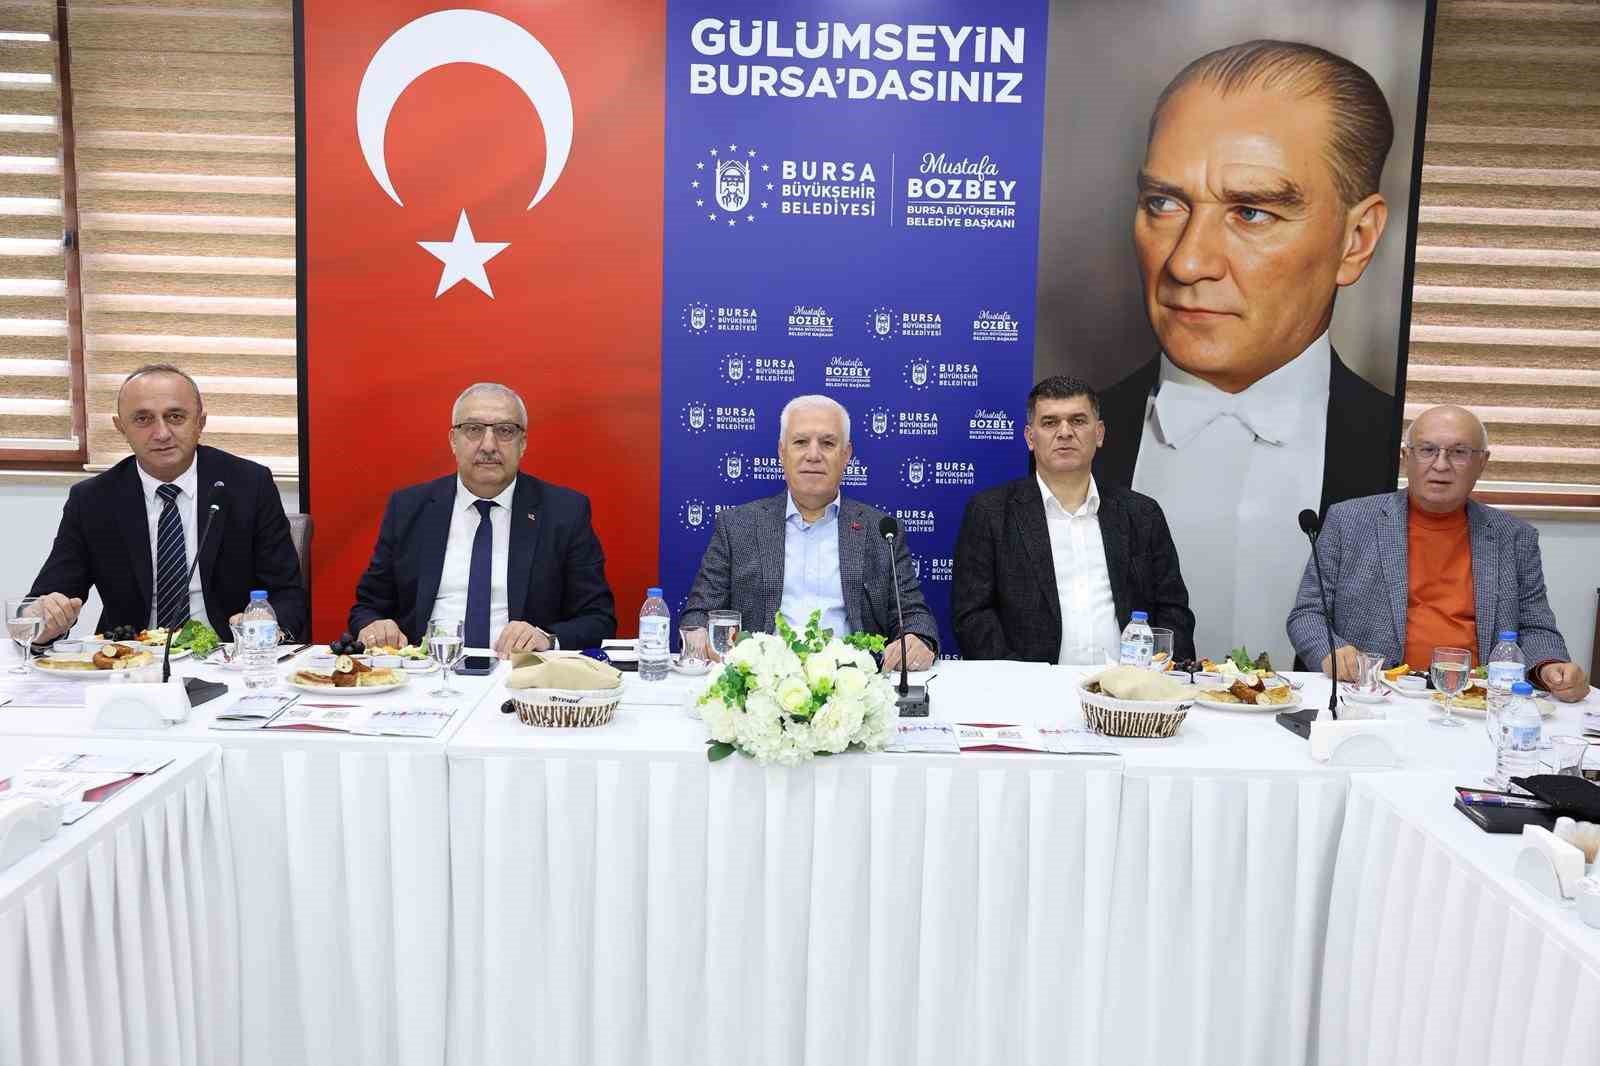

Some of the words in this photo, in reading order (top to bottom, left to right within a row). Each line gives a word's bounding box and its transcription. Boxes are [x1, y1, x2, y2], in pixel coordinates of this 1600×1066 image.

[690, 17, 1025, 64] GÜLÜMSEYİN
[782, 160, 876, 182] BURSA
[920, 152, 1000, 182] Mustafa
[782, 182, 875, 200] BÜYÜKŞEHİR
[907, 178, 1016, 200] BOZBEY
[781, 200, 875, 216] BELEDİYESİ
[907, 205, 944, 215] BURSA
[946, 205, 1015, 217] BÜYÜKŞEHİR
[906, 216, 961, 227] BELEDİYE
[964, 217, 1015, 230] BAŞKANI
[718, 308, 757, 317] BURSA
[788, 316, 833, 325] BOZBEY
[903, 313, 941, 322] BURSA
[973, 320, 1018, 329] BOZBEY
[756, 359, 794, 368] BURSA
[939, 364, 978, 372] BURSA
[825, 367, 871, 376] BOZBEY
[717, 408, 755, 416] BURSA
[900, 413, 938, 421] BURSA
[970, 420, 1014, 428] BOZBEY
[754, 458, 784, 466] BURS
[936, 462, 974, 470] BURSA
[844, 466, 868, 475] BEY
[897, 510, 934, 518] BURSA
[932, 559, 953, 567] BUR
